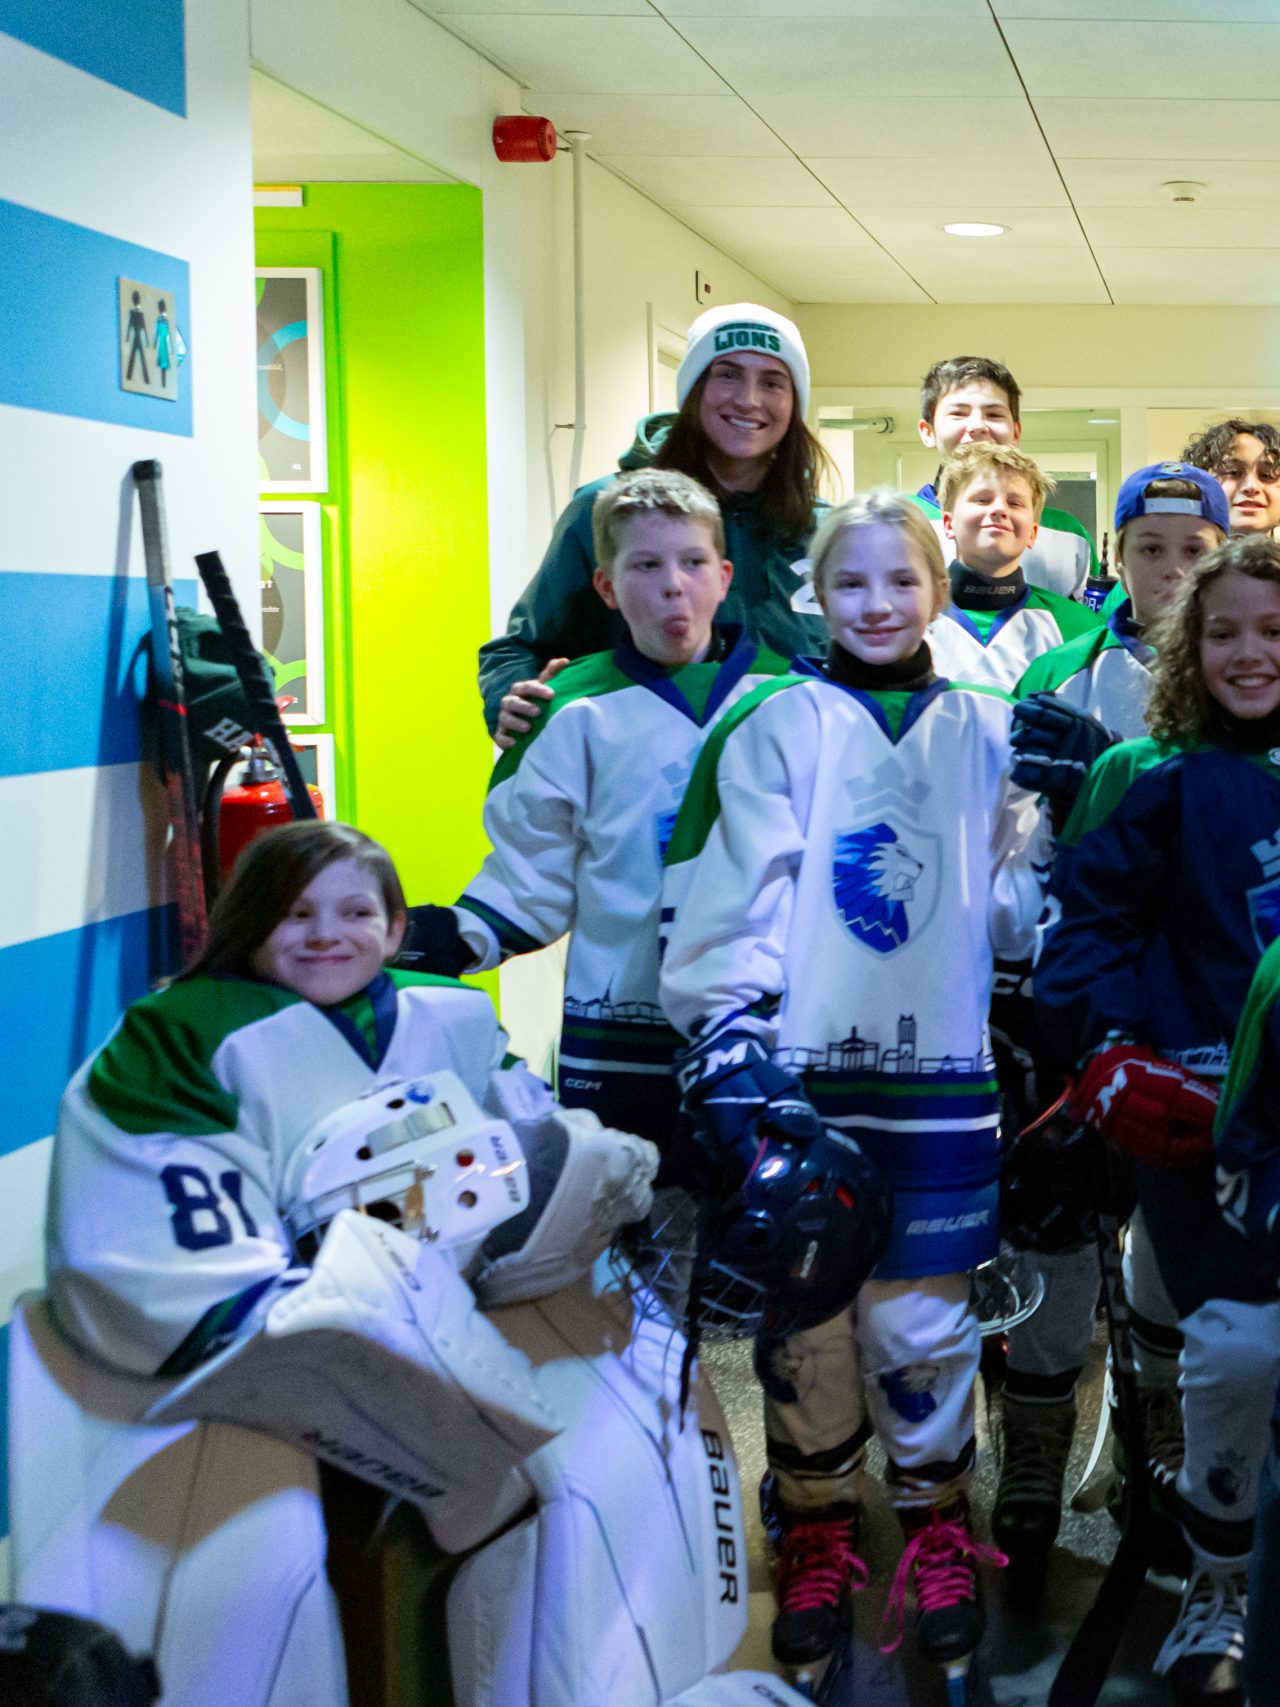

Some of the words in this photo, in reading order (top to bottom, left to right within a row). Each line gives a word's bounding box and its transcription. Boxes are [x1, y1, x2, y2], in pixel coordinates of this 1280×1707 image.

[715, 330, 781, 352] LIONS
[159, 1163, 259, 1253] 81
[906, 1208, 991, 1236] BAUER
[701, 1428, 739, 1605] BAUER
